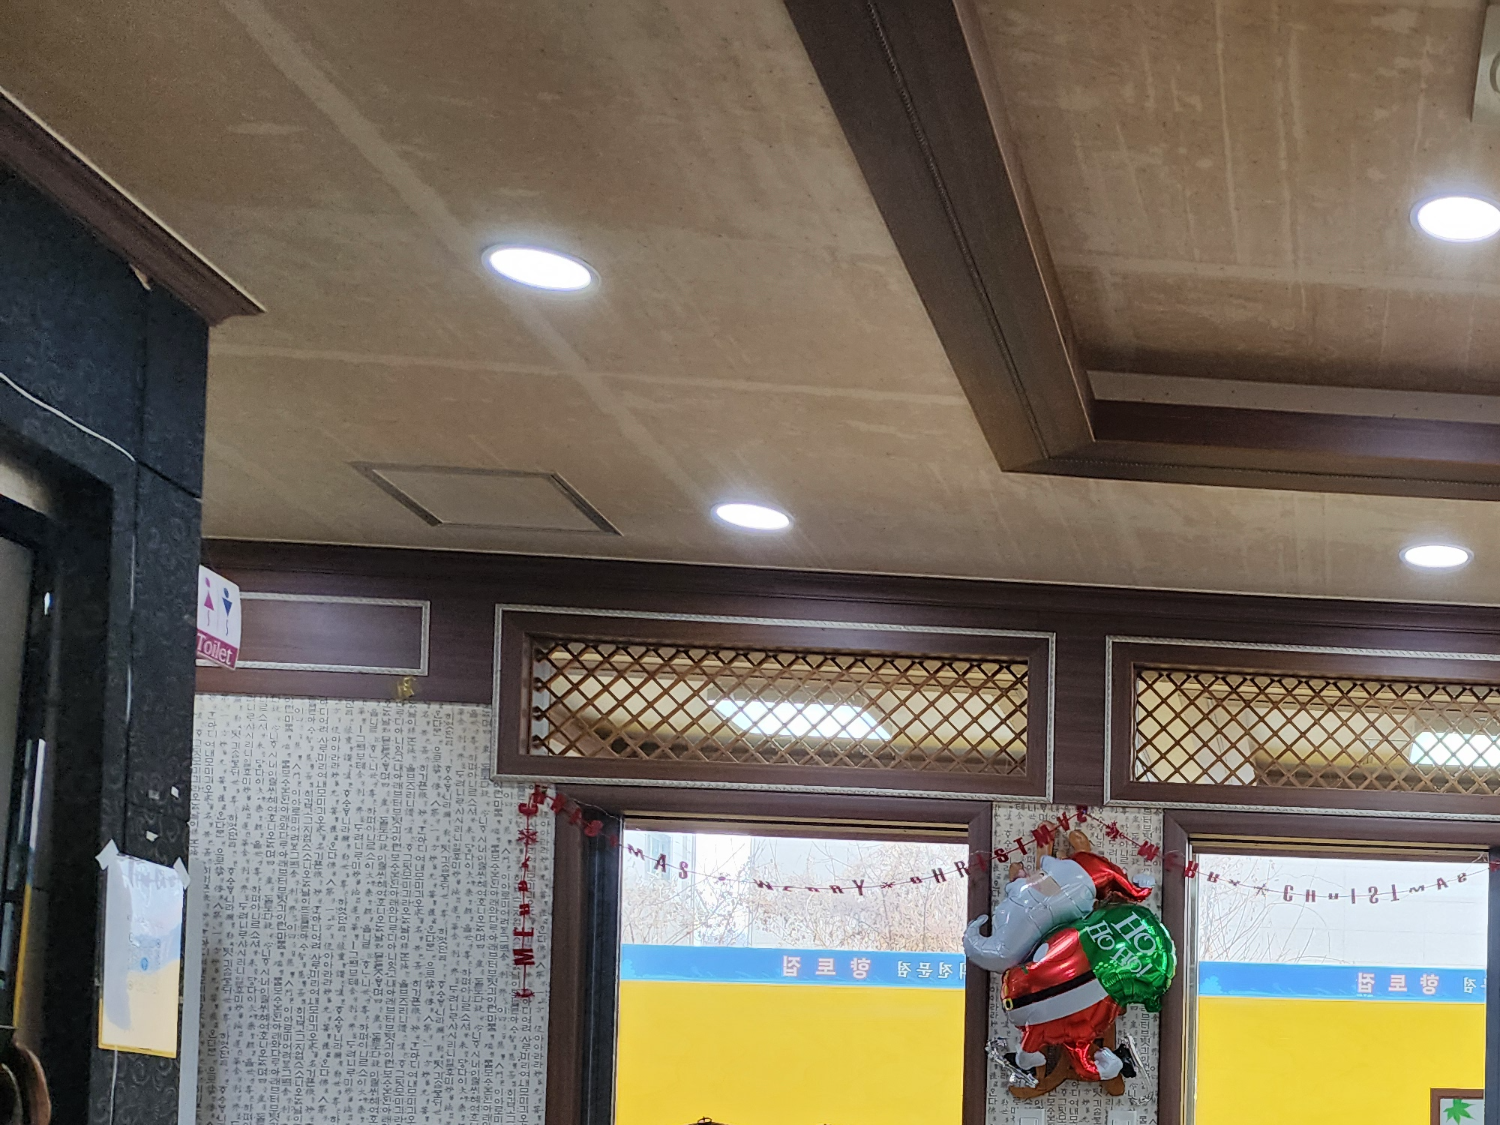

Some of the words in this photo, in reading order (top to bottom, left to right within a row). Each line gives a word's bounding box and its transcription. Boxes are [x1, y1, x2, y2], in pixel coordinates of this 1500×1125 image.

[197, 632, 233, 666] Toilet
[1086, 919, 1116, 951] HO
[1110, 911, 1157, 954] HO
